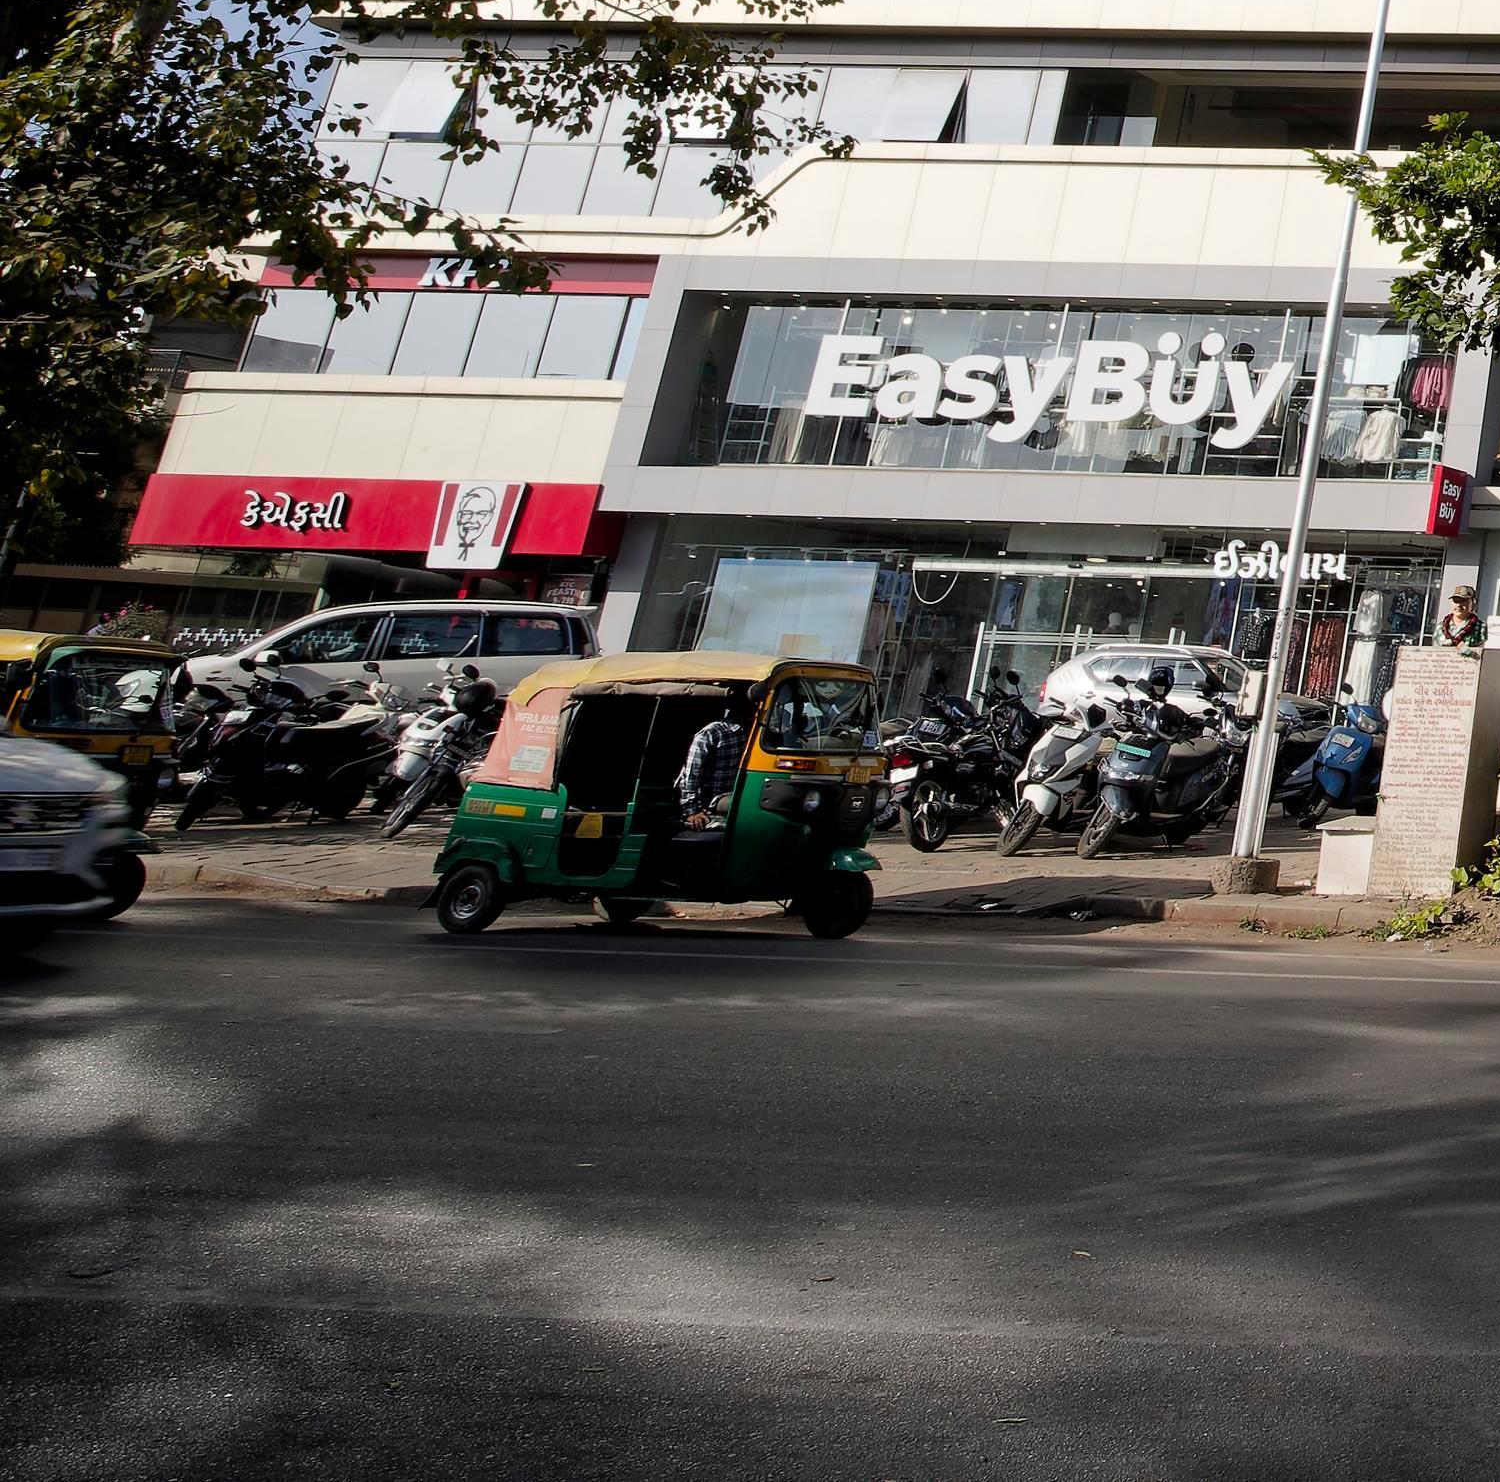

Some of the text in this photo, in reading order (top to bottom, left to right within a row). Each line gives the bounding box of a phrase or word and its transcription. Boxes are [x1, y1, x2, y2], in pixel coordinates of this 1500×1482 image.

[417, 257, 510, 288] KF
[802, 329, 1296, 449] EasyBüy
[1442, 479, 1462, 501] Easy
[240, 489, 347, 532] કેએફસી
[1438, 502, 1457, 524] Büy
